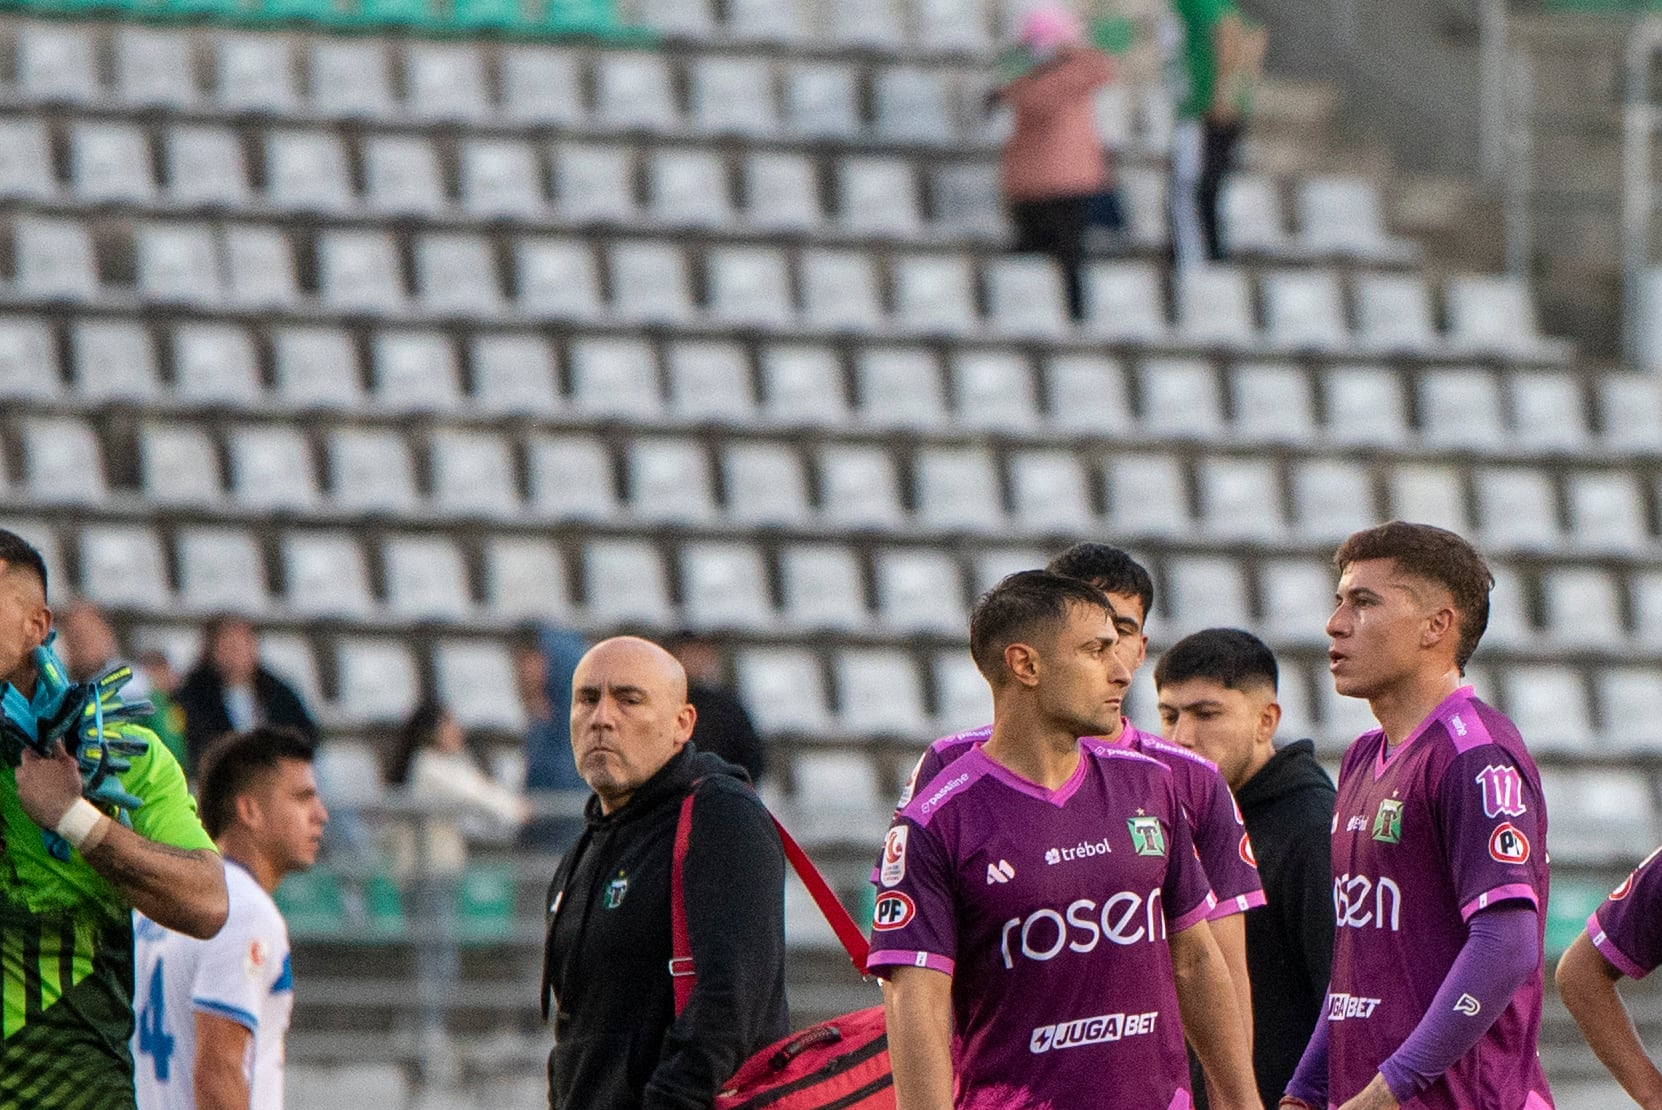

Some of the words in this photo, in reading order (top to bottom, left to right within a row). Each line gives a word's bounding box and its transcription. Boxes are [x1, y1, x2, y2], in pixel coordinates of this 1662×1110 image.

[928, 772, 970, 806] passline
[1061, 838, 1112, 863] trébol
[877, 898, 902, 923] PF
[1001, 887, 1166, 969] rosen
